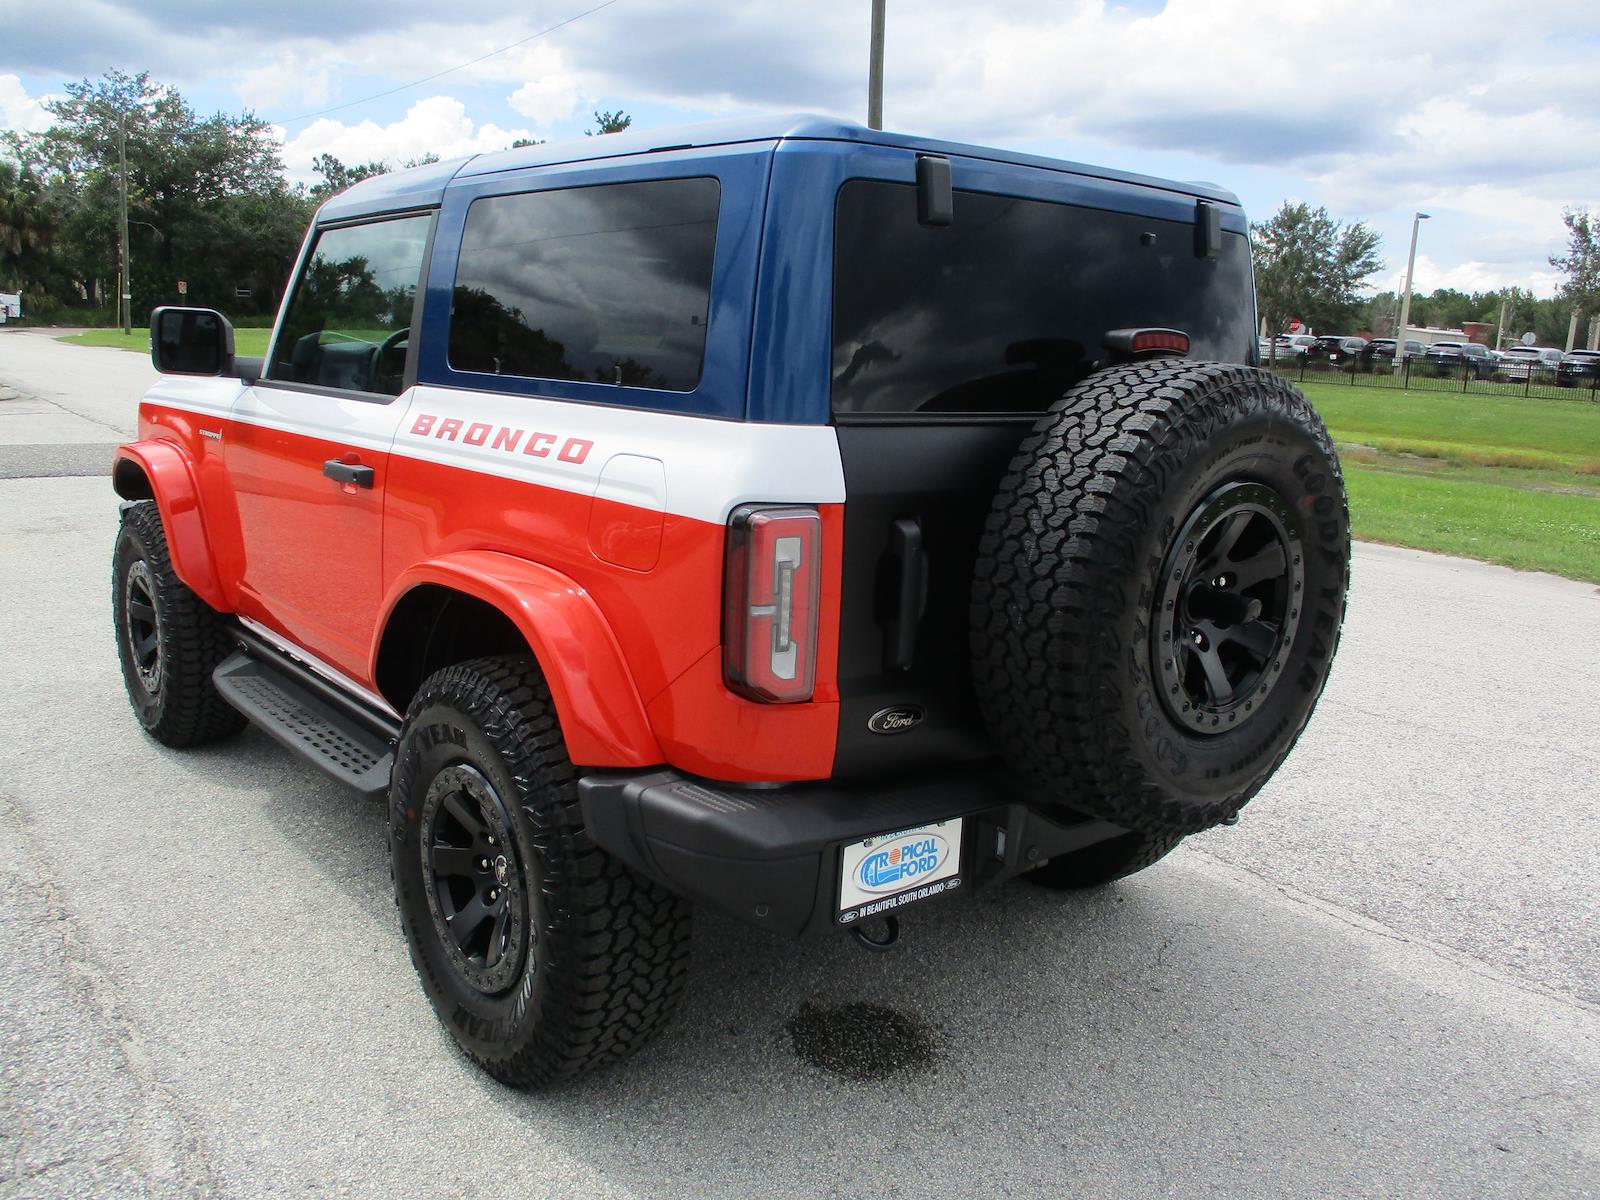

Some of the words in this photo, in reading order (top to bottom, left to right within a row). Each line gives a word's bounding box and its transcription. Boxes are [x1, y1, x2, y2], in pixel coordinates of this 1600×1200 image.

[410, 414, 594, 464] BRONCO
[1293, 454, 1344, 693] GOODYEAR
[883, 712, 914, 729] Ford
[861, 838, 938, 887] TROPICAL
[900, 855, 938, 878] FORD
[860, 907, 867, 918] IN
[867, 898, 898, 915] BEAUTIFUL
[898, 891, 918, 905] SOUTH
[918, 882, 944, 899] ORLANDO
